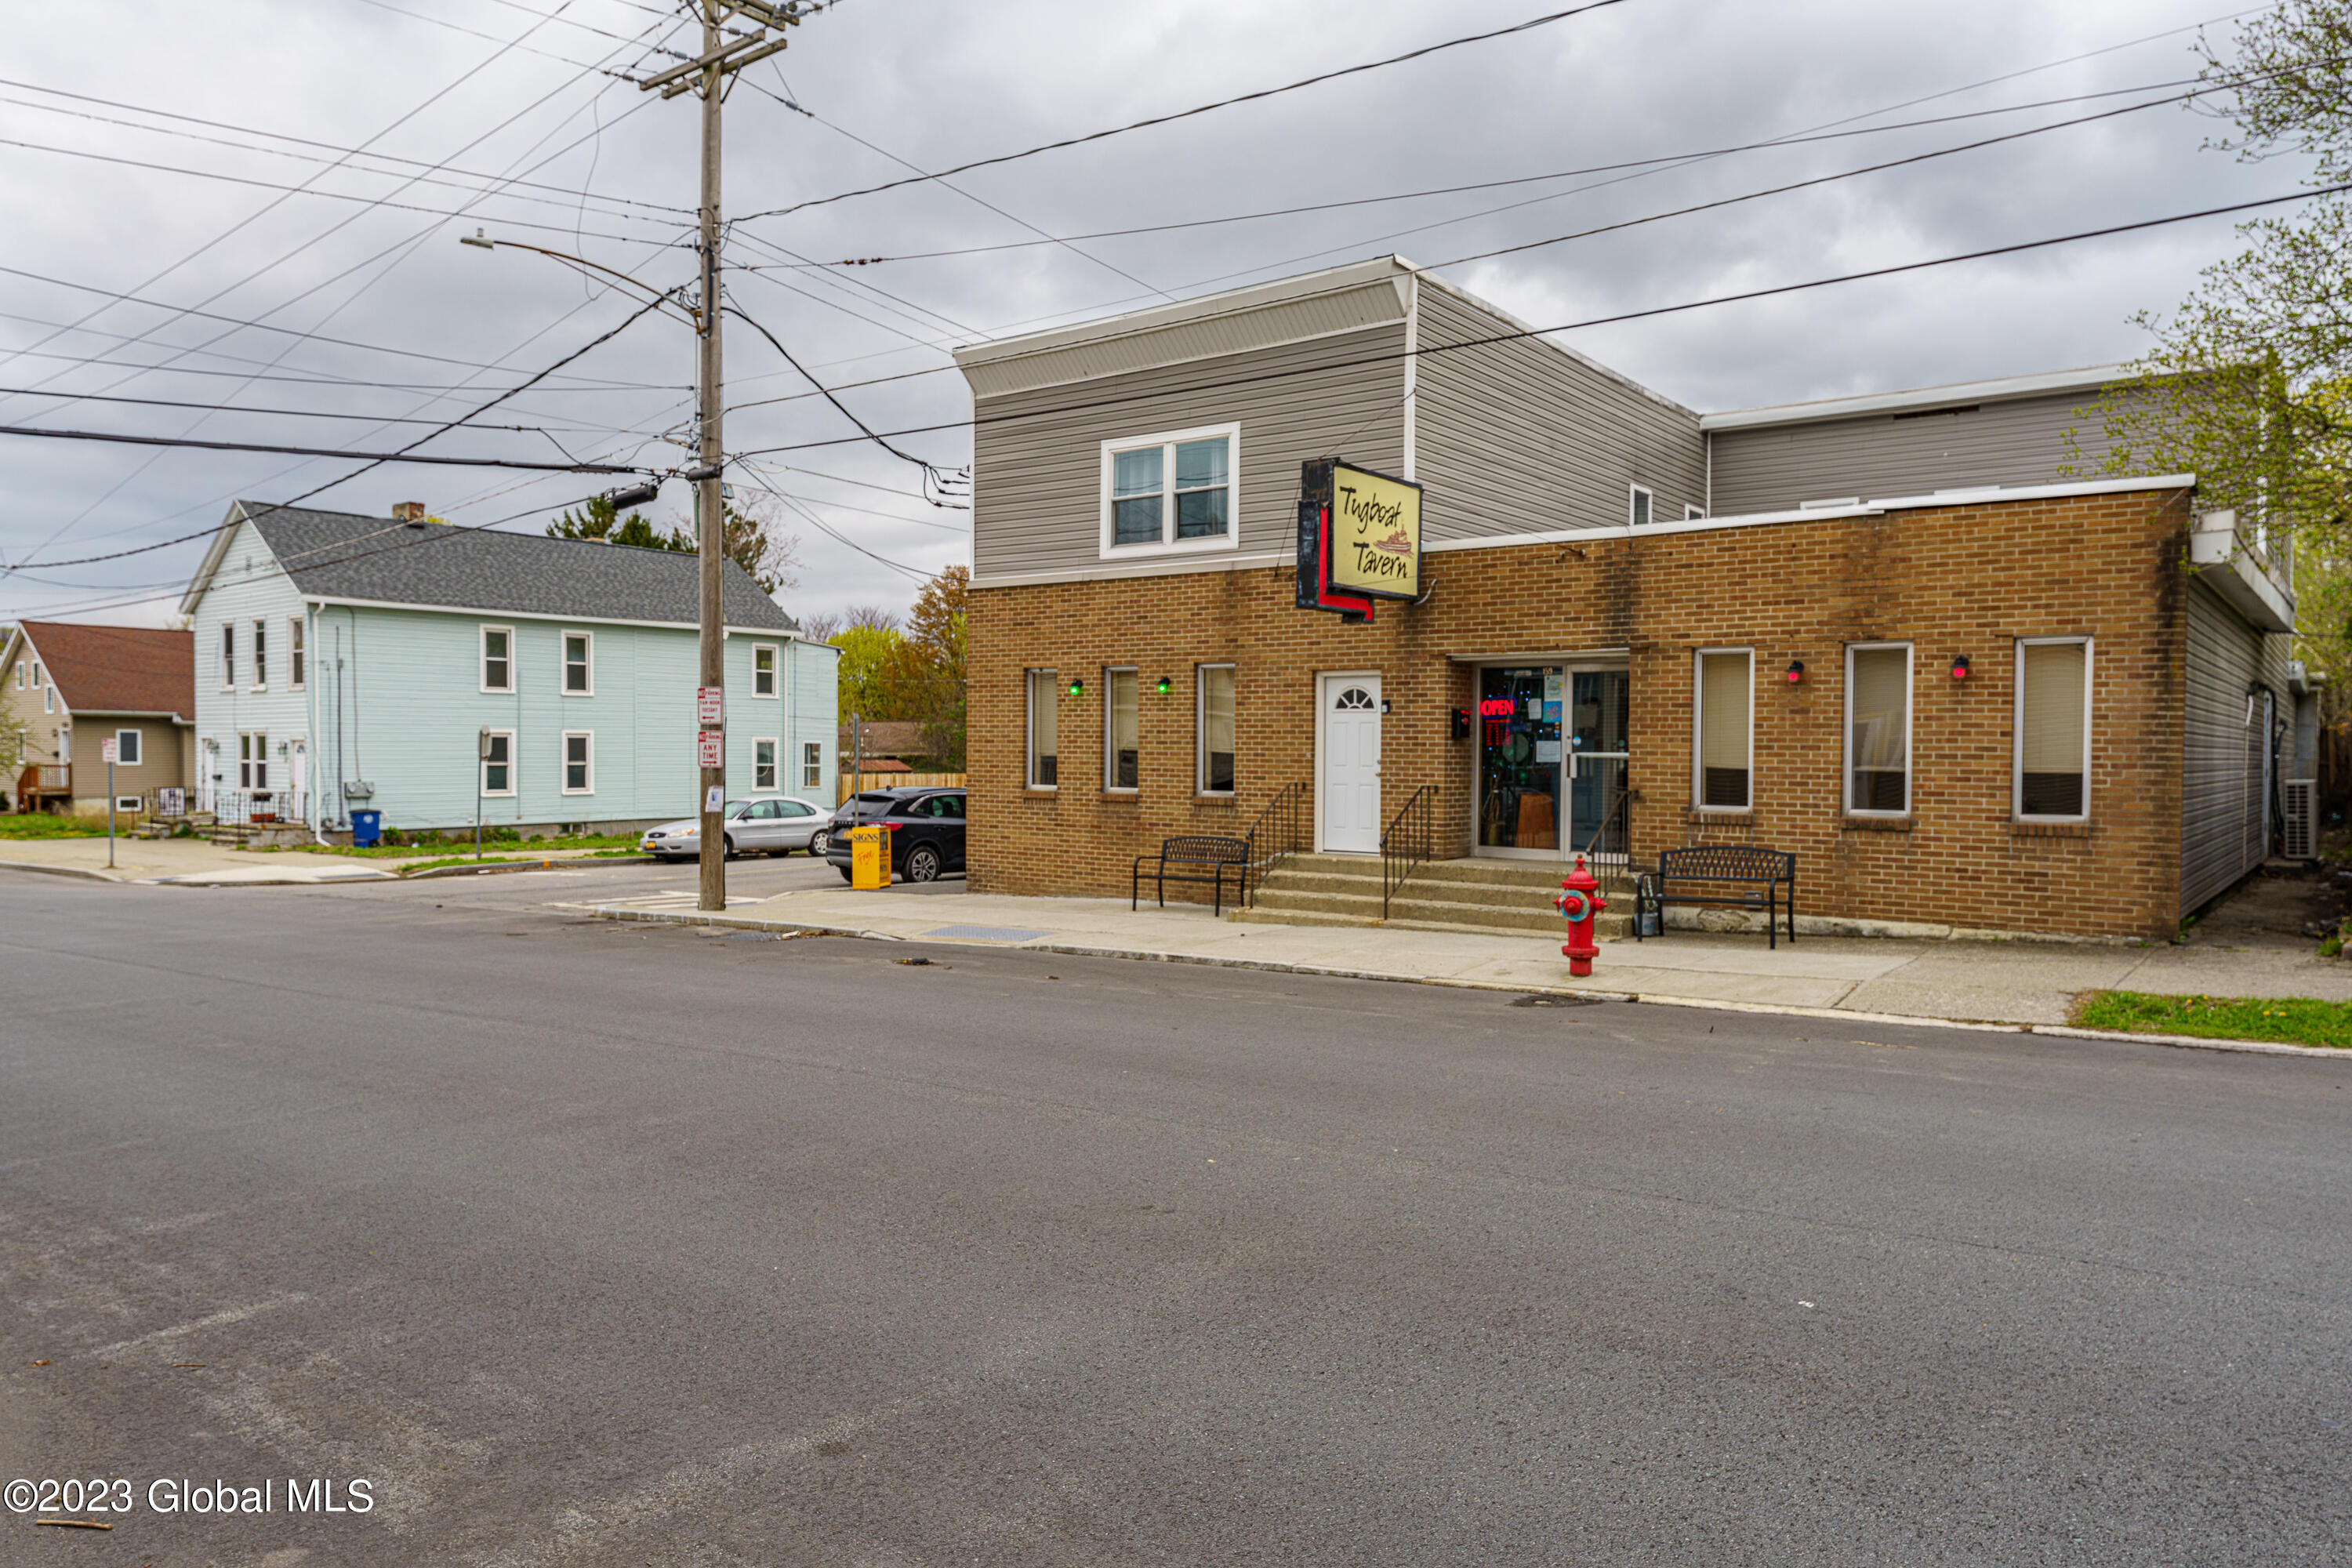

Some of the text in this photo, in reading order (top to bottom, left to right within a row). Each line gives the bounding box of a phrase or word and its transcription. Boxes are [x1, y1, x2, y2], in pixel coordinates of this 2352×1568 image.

[1339, 486, 1402, 534] Tugboat
[1353, 542, 1408, 579] Tavern
[1481, 699, 1514, 716] OPEN
